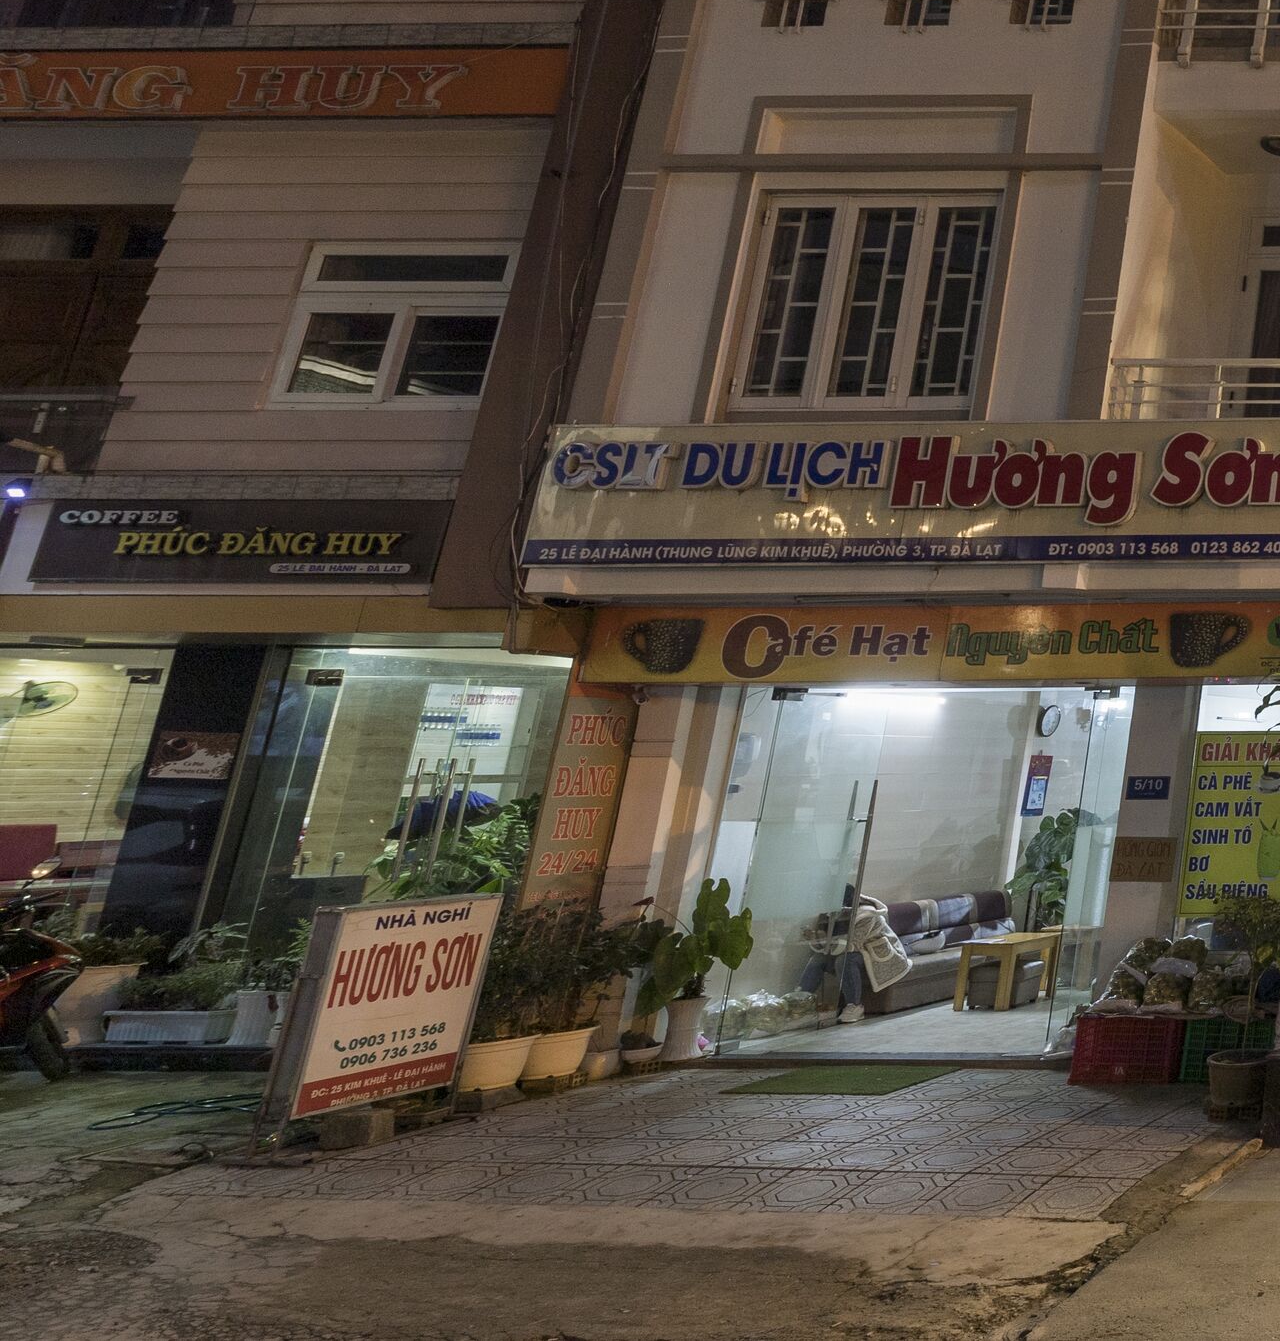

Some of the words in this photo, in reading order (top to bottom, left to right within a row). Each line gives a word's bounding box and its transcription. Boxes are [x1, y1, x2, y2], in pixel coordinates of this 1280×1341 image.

[0, 53, 193, 112] ĂNG
[227, 64, 468, 111] HUY
[553, 441, 675, 491] CSLT
[681, 441, 766, 491] DU
[763, 440, 893, 503] LỊCH
[889, 435, 1142, 526] Hương
[59, 509, 179, 524] COFFEE
[113, 527, 210, 555] PHÚC
[217, 526, 316, 555] ĐĂNG
[322, 532, 402, 555] HUY
[539, 547, 558, 560] 25
[579, 545, 608, 563] ĐẠI
[609, 542, 653, 559] HÀNH
[655, 545, 712, 561] (THUNG
[717, 542, 758, 559] LŨNG
[760, 546, 789, 559] KIM
[842, 540, 908, 558] PHƯỜNG
[912, 545, 928, 559] 3,
[1077, 542, 1115, 556] 0903
[1119, 542, 1147, 555] 113
[1150, 542, 1180, 555] 568
[1190, 542, 1227, 555] 0123
[1230, 542, 1261, 555] 862
[721, 613, 842, 679] Café
[848, 625, 932, 663] Hạt
[945, 622, 1073, 666] Nguyên
[1078, 617, 1160, 654] Chất
[566, 707, 628, 746] PHÚC
[1202, 737, 1240, 762] GIẢI
[553, 756, 616, 797] ĐĂNG
[1134, 778, 1164, 791] 5/10
[1197, 771, 1218, 790] CÀ
[1222, 771, 1253, 790] PHÊ
[1194, 802, 1229, 818] CAM
[1234, 795, 1263, 818] VẮT
[551, 807, 603, 841] HUY
[1191, 829, 1229, 845] SINH
[1233, 823, 1253, 845] TỐ
[536, 848, 598, 877] 24/24
[1188, 854, 1211, 872] BƠ
[375, 910, 417, 931] NHÀ
[423, 901, 474, 926] NGHỈ
[327, 940, 427, 1009] HƯƠNG
[425, 931, 483, 993] SƠN
[348, 1036, 385, 1051] 0903
[391, 1028, 416, 1043] 113
[420, 1022, 446, 1037] 568
[339, 1051, 377, 1070] 0906
[382, 1045, 408, 1062] 736
[411, 1039, 438, 1055] 236
[331, 1084, 342, 1094] 25
[344, 1080, 363, 1092] KIM
